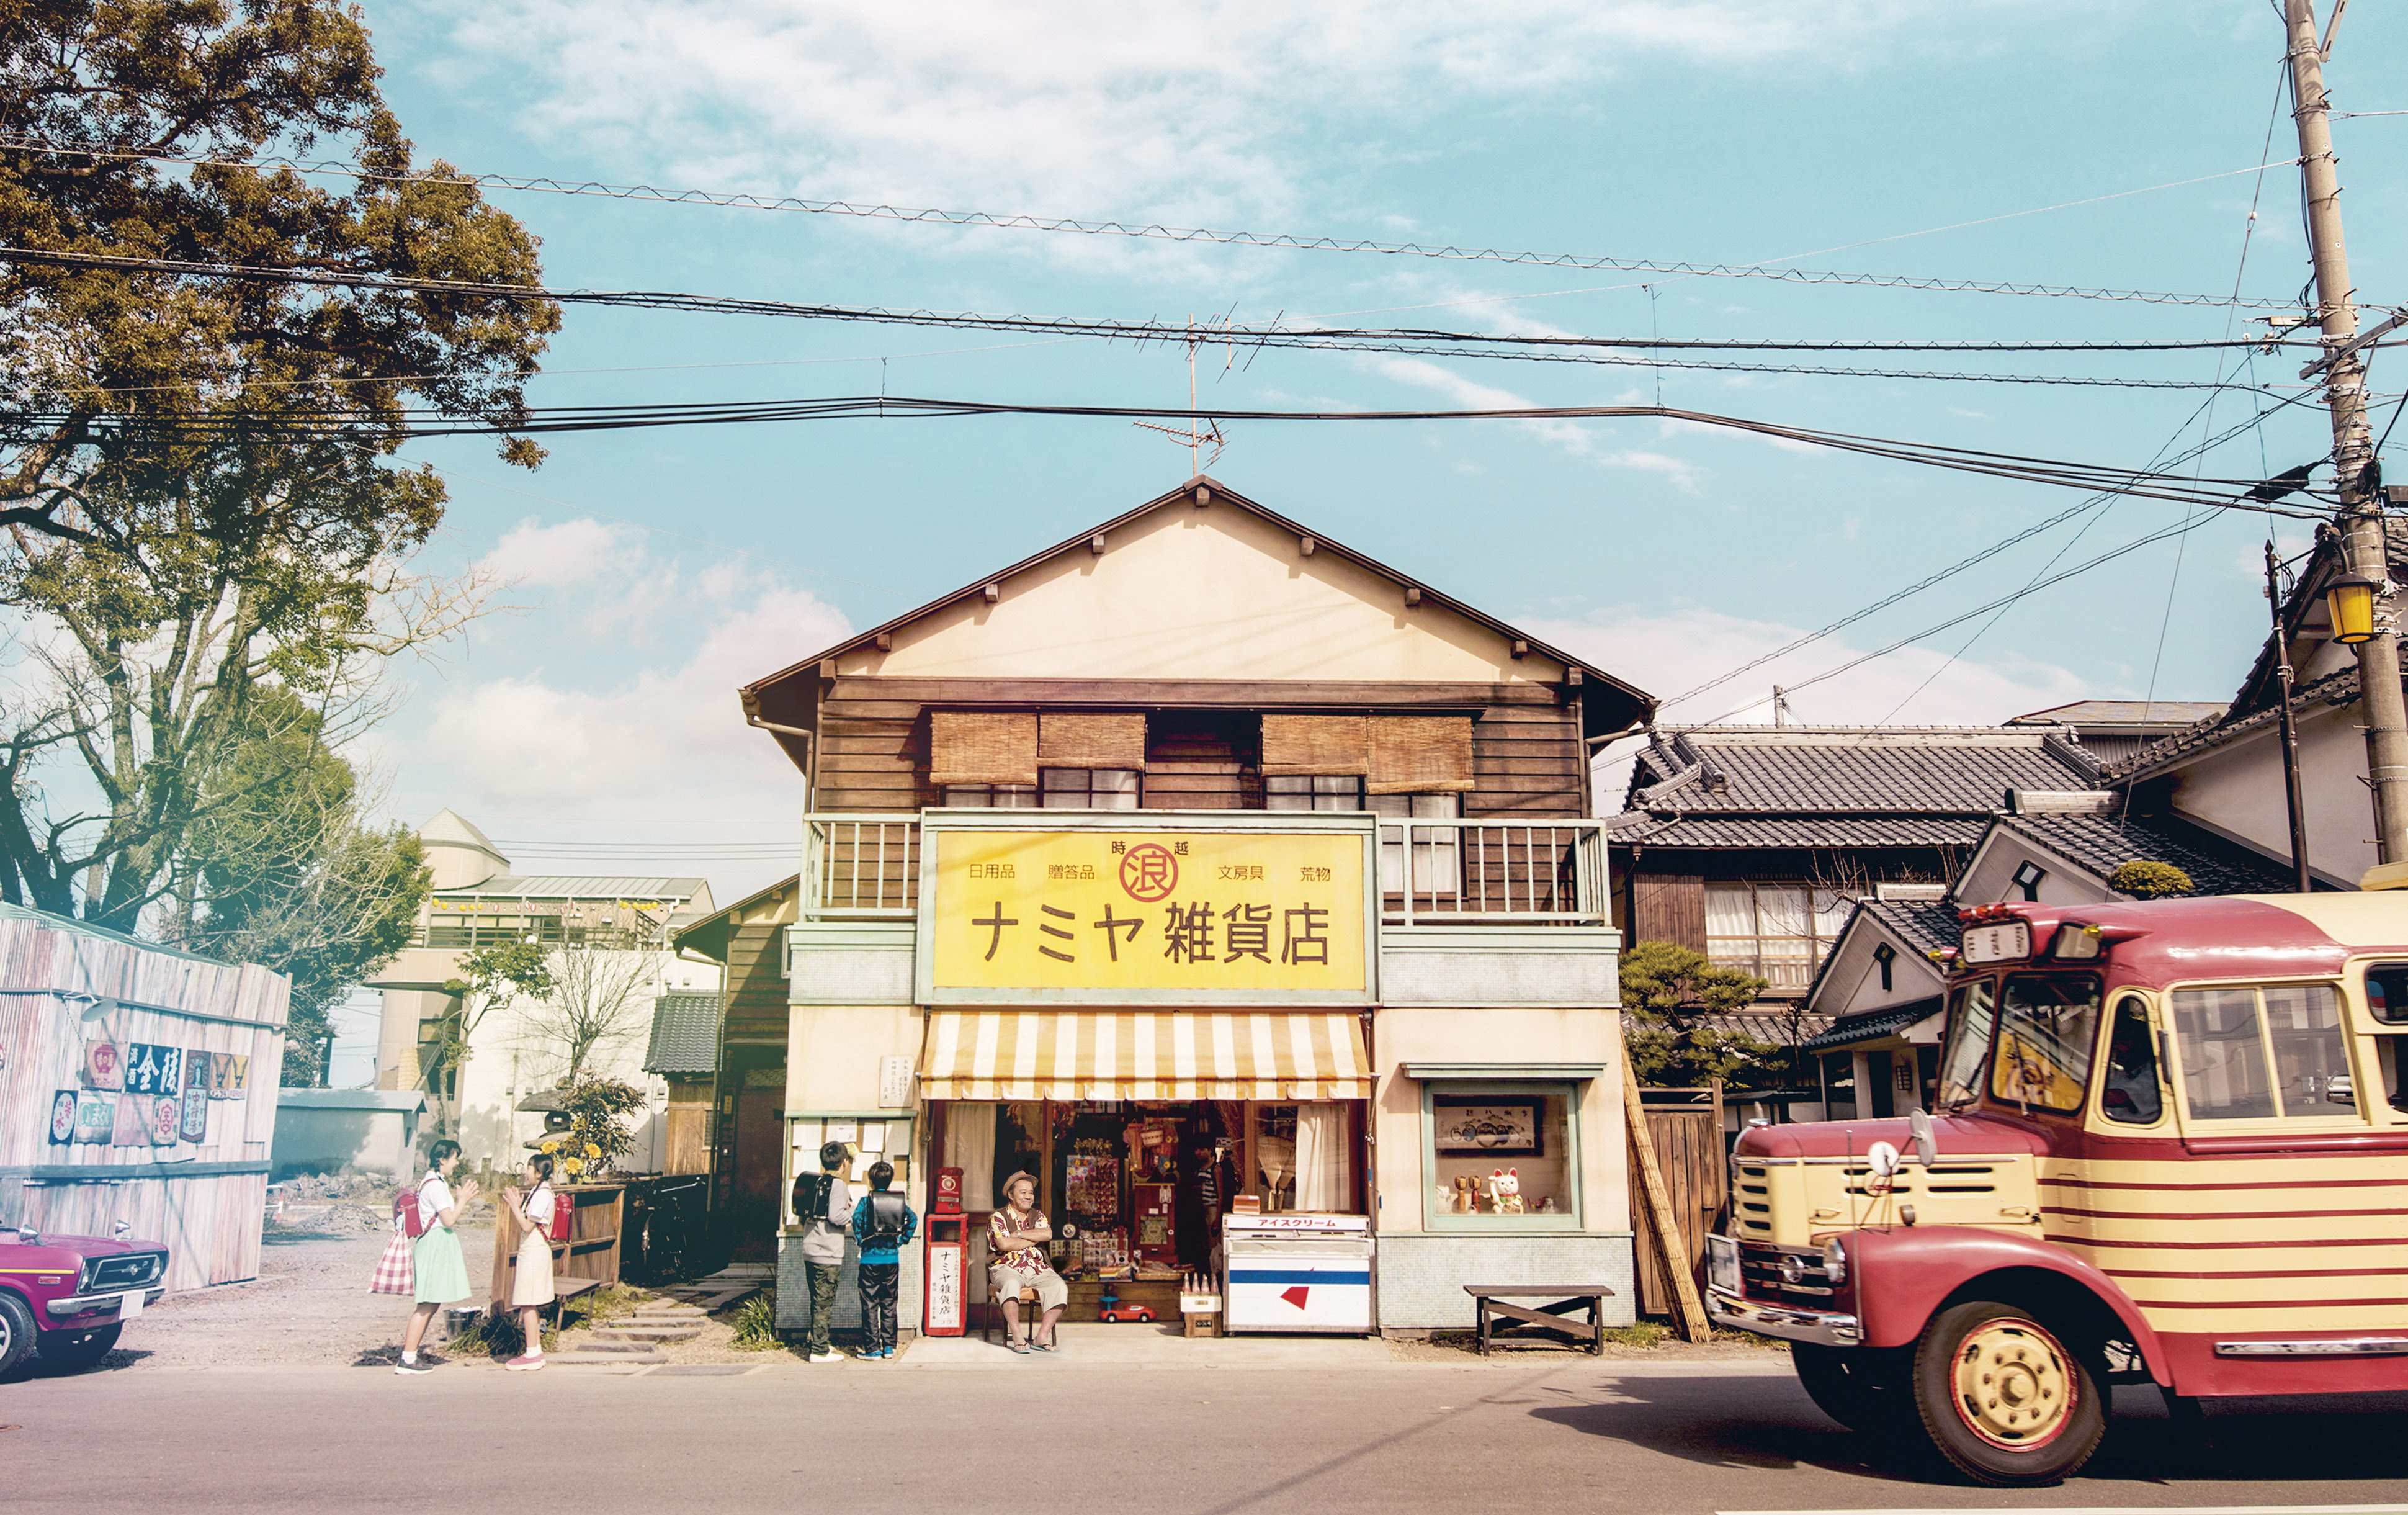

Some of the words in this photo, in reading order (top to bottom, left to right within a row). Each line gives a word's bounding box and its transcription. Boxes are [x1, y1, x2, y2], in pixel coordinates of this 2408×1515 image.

[1112, 841, 1126, 855] 時
[1175, 842, 1188, 855] 越
[970, 863, 1015, 879] 日用品
[1048, 864, 1094, 879] 贈答品
[1218, 865, 1264, 881] 文房具
[1300, 866, 1331, 882] 荒物
[1125, 849, 1171, 894] 浪
[972, 901, 1328, 966] ナミヤ雑貨店
[1258, 1219, 1336, 1227] アイスクリーム
